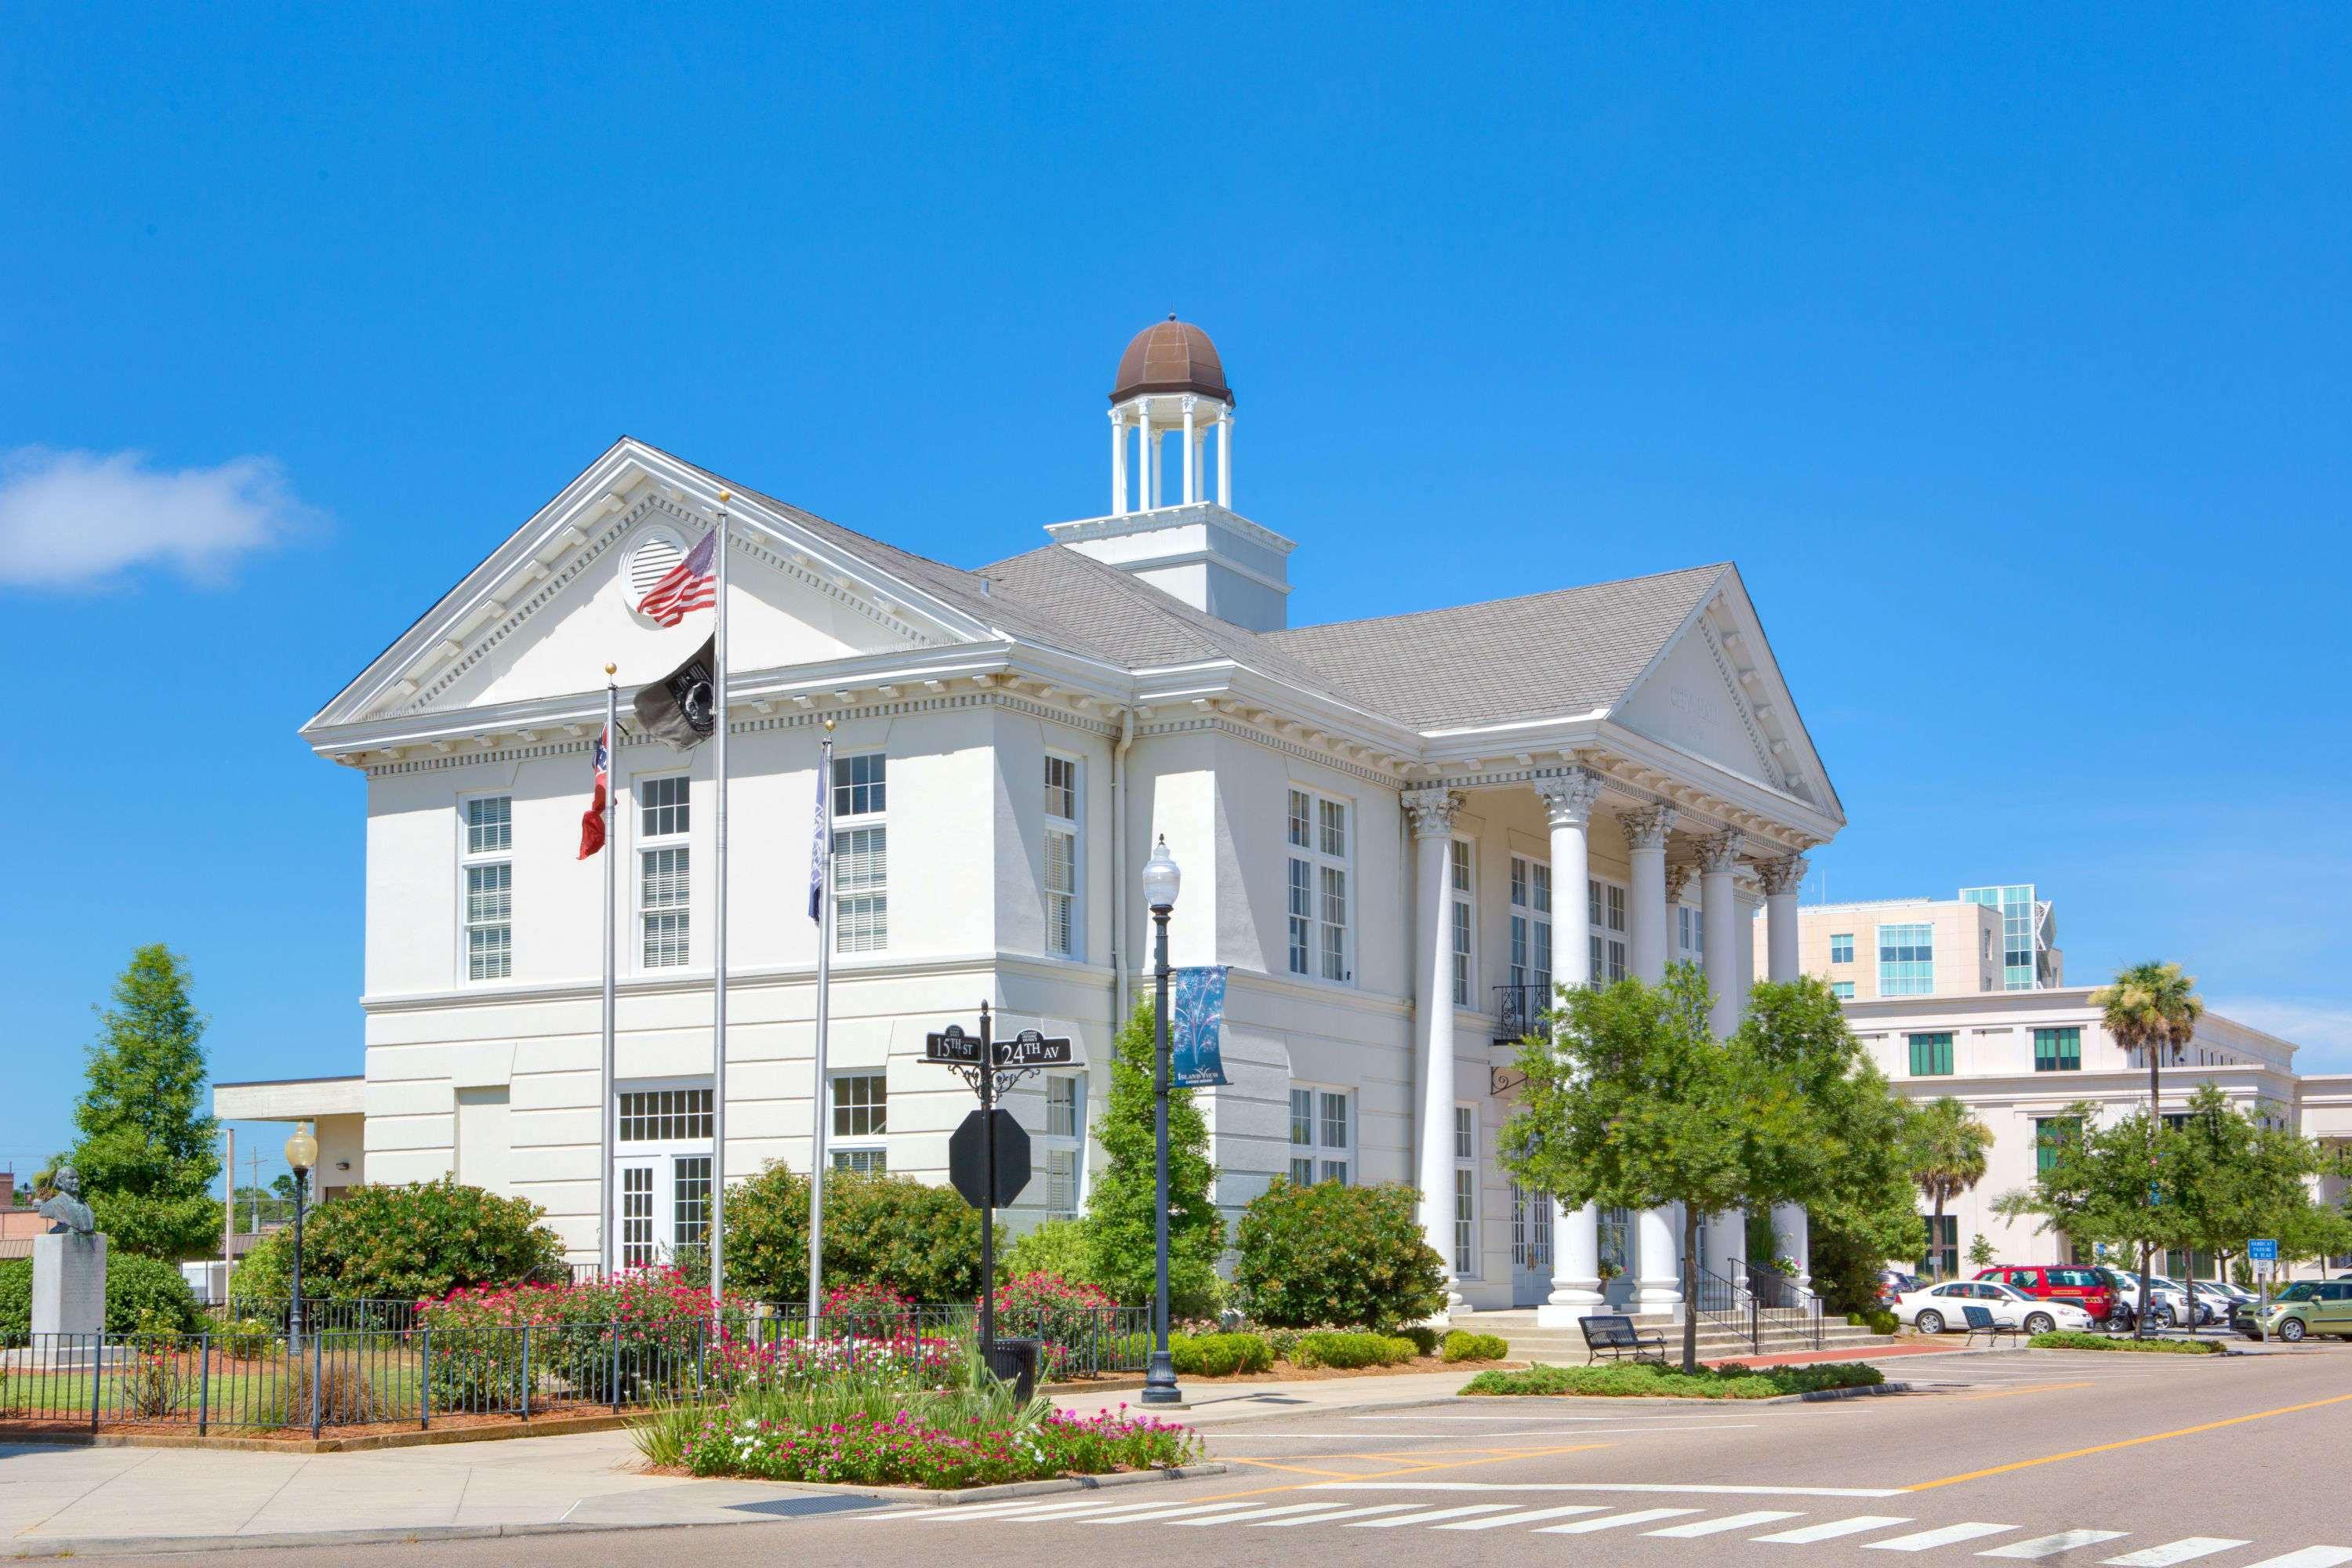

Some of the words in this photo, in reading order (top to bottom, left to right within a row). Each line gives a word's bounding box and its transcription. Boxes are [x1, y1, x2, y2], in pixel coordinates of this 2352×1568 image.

[936, 1037, 961, 1057] 15TH
[963, 1044, 972, 1054] ST
[1002, 1042, 1040, 1065] 24TH
[1044, 1047, 1059, 1058] AV
